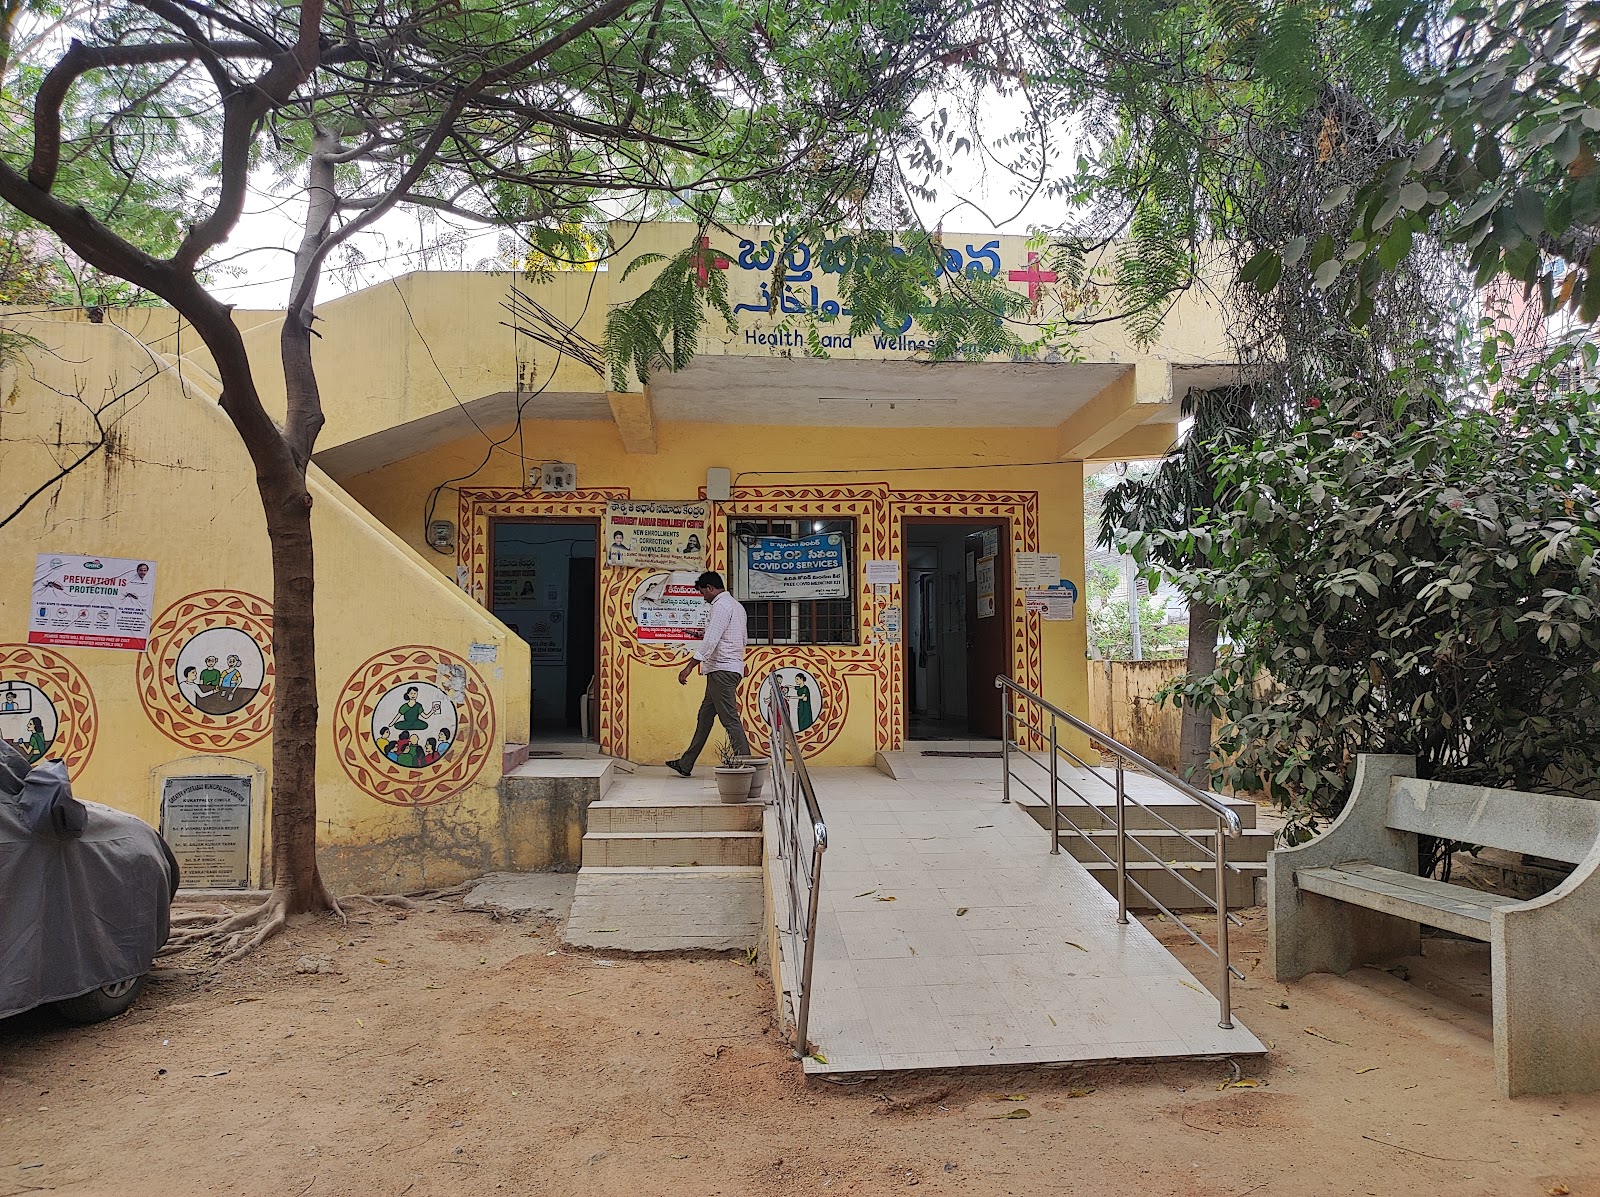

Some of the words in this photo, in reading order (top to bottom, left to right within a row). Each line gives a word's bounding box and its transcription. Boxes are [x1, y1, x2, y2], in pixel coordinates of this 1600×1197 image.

[745, 329, 803, 346] Health
[821, 334, 852, 348] and
[639, 538, 673, 546] CORRECTIONS
[752, 562, 780, 570] COVID
[796, 560, 838, 568] SERVICES
[63, 575, 115, 586] PREVENTION
[118, 578, 127, 587] IS
[69, 586, 118, 596] PROTECTION
[168, 791, 184, 804] GREATER
[184, 784, 204, 795] HYDERABAD
[222, 786, 245, 802] CORPORATION
